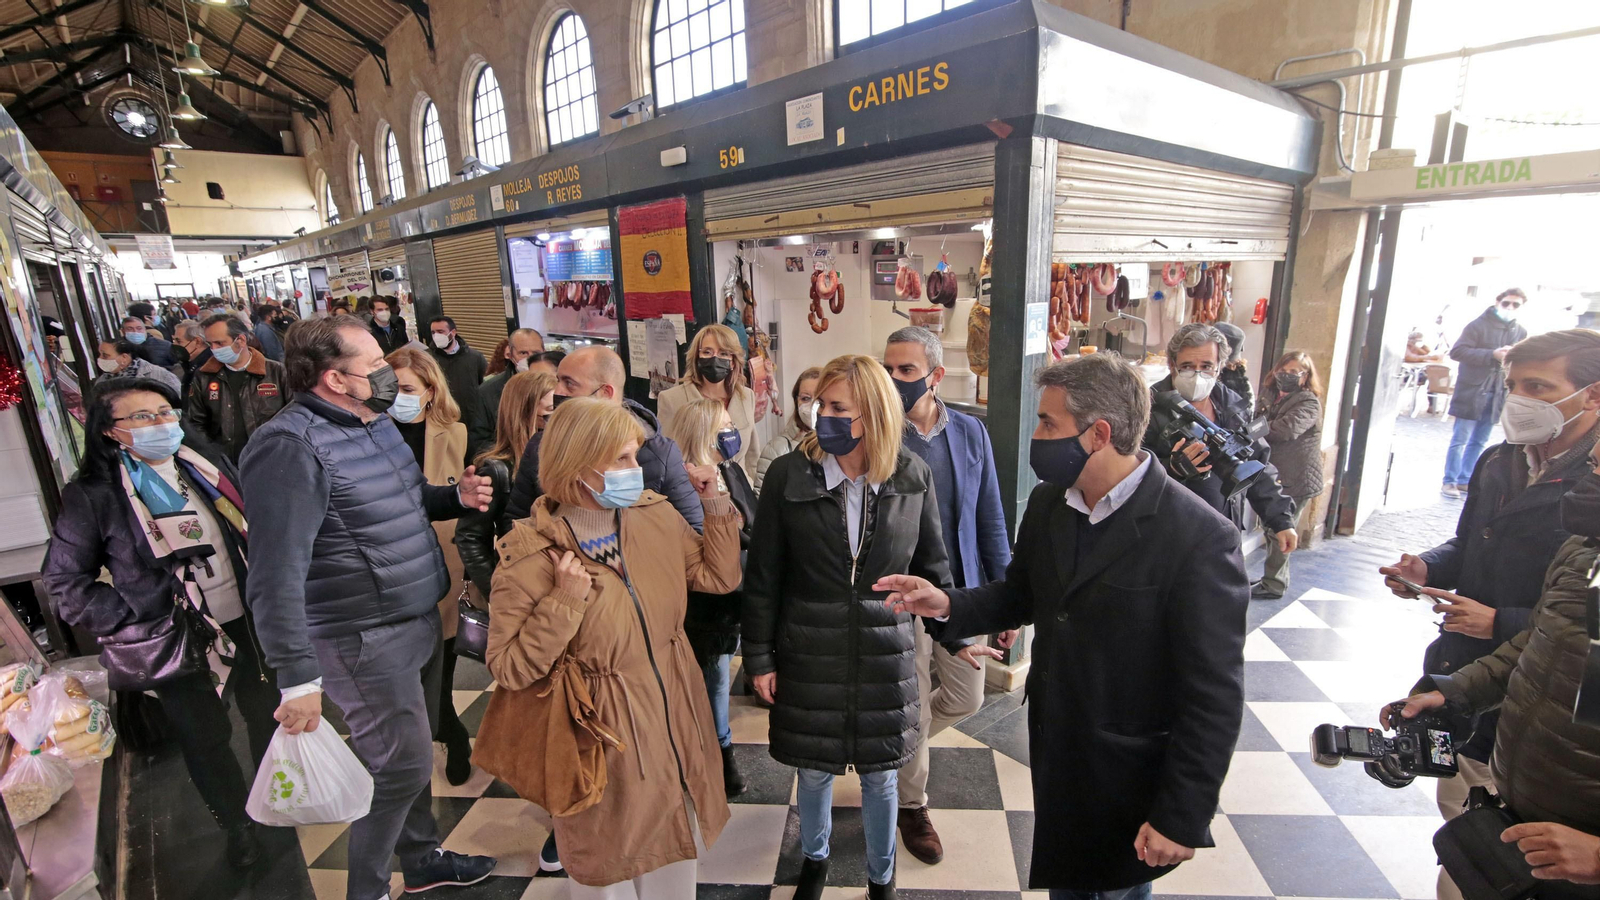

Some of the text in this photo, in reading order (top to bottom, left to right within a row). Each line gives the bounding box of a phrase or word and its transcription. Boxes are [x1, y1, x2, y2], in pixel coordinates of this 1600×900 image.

[848, 61, 950, 112] CARNES
[719, 145, 738, 169] 59
[503, 164, 580, 197] MOLLEJA DESPOJOS
[1416, 158, 1532, 190] ENTRADA
[449, 194, 476, 211] DESPOJOS
[505, 198, 515, 213] 60
[556, 183, 582, 203] REYES
